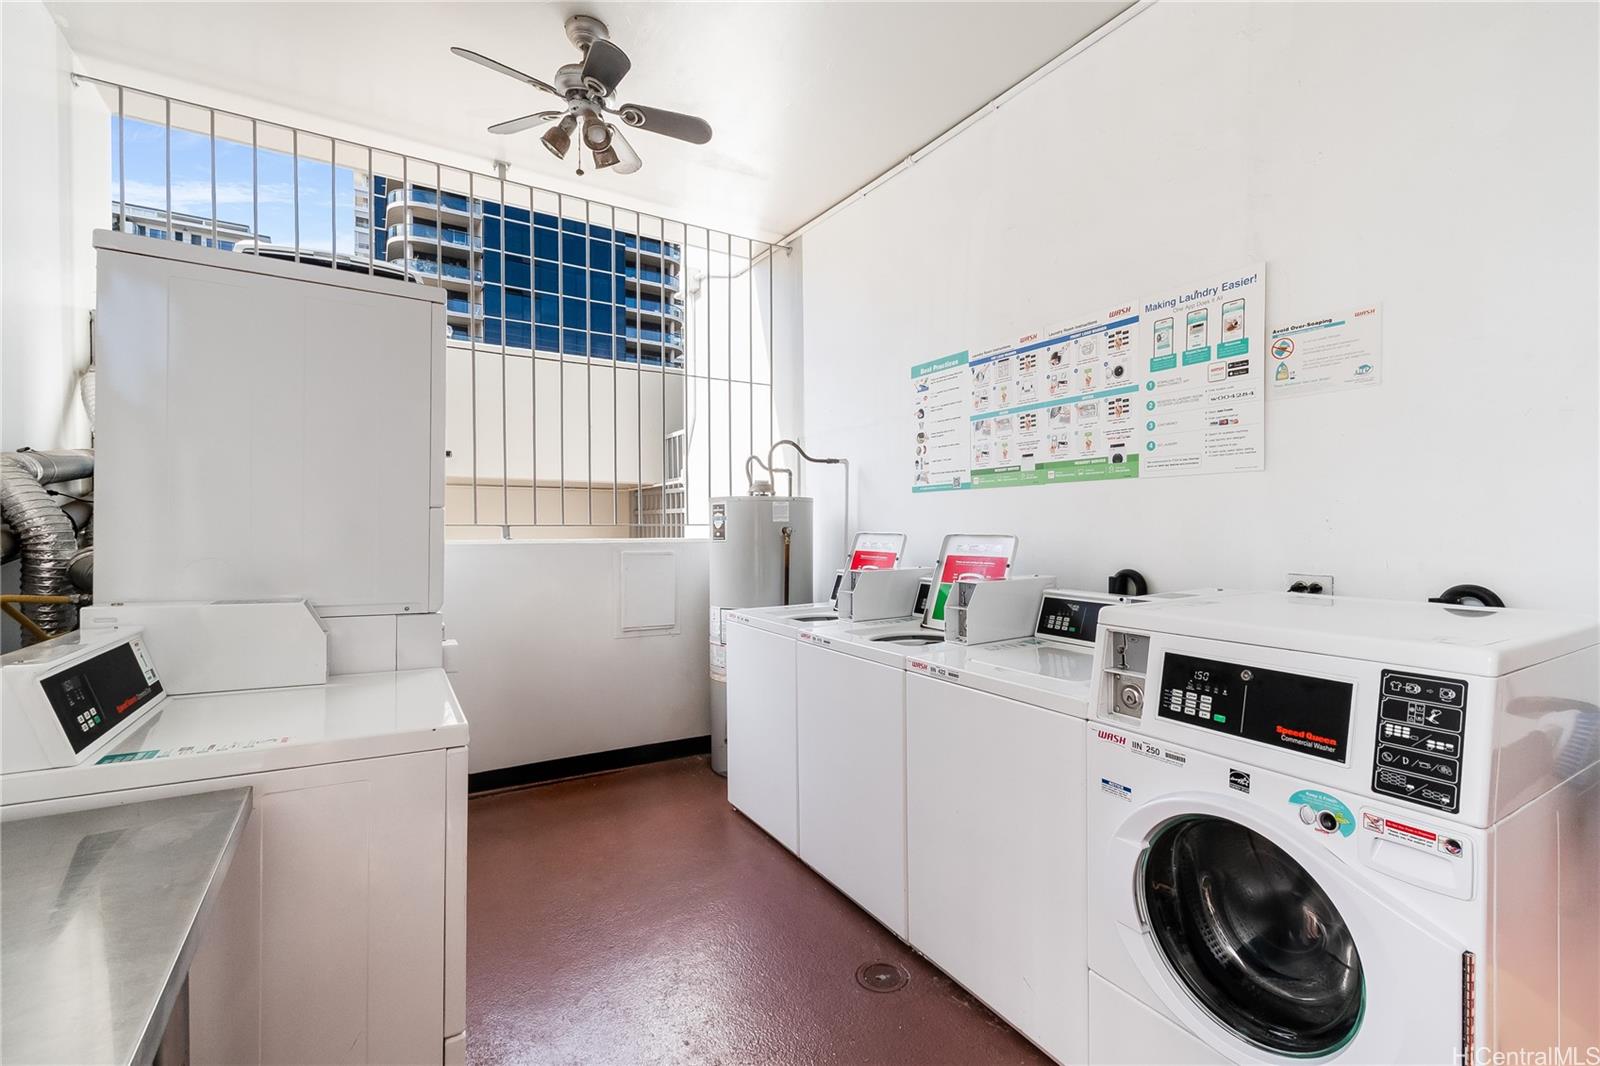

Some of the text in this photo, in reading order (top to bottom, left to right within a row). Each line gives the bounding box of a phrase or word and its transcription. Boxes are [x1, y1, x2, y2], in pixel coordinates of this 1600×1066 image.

[1145, 274, 1258, 313] Making Laundry Easier!
[1109, 306, 1131, 318] WASH
[1354, 308, 1376, 318] WASH
[1272, 318, 1332, 335] Avoid Over-Soaping
[1020, 334, 1038, 343] WASH
[920, 359, 959, 375] Best Practices
[912, 660, 928, 670] WASH
[1098, 730, 1126, 745] WASH
[1146, 746, 1160, 756] 250
[1276, 725, 1337, 746] Speed Queen
[1281, 735, 1336, 753] Commercial Washer
